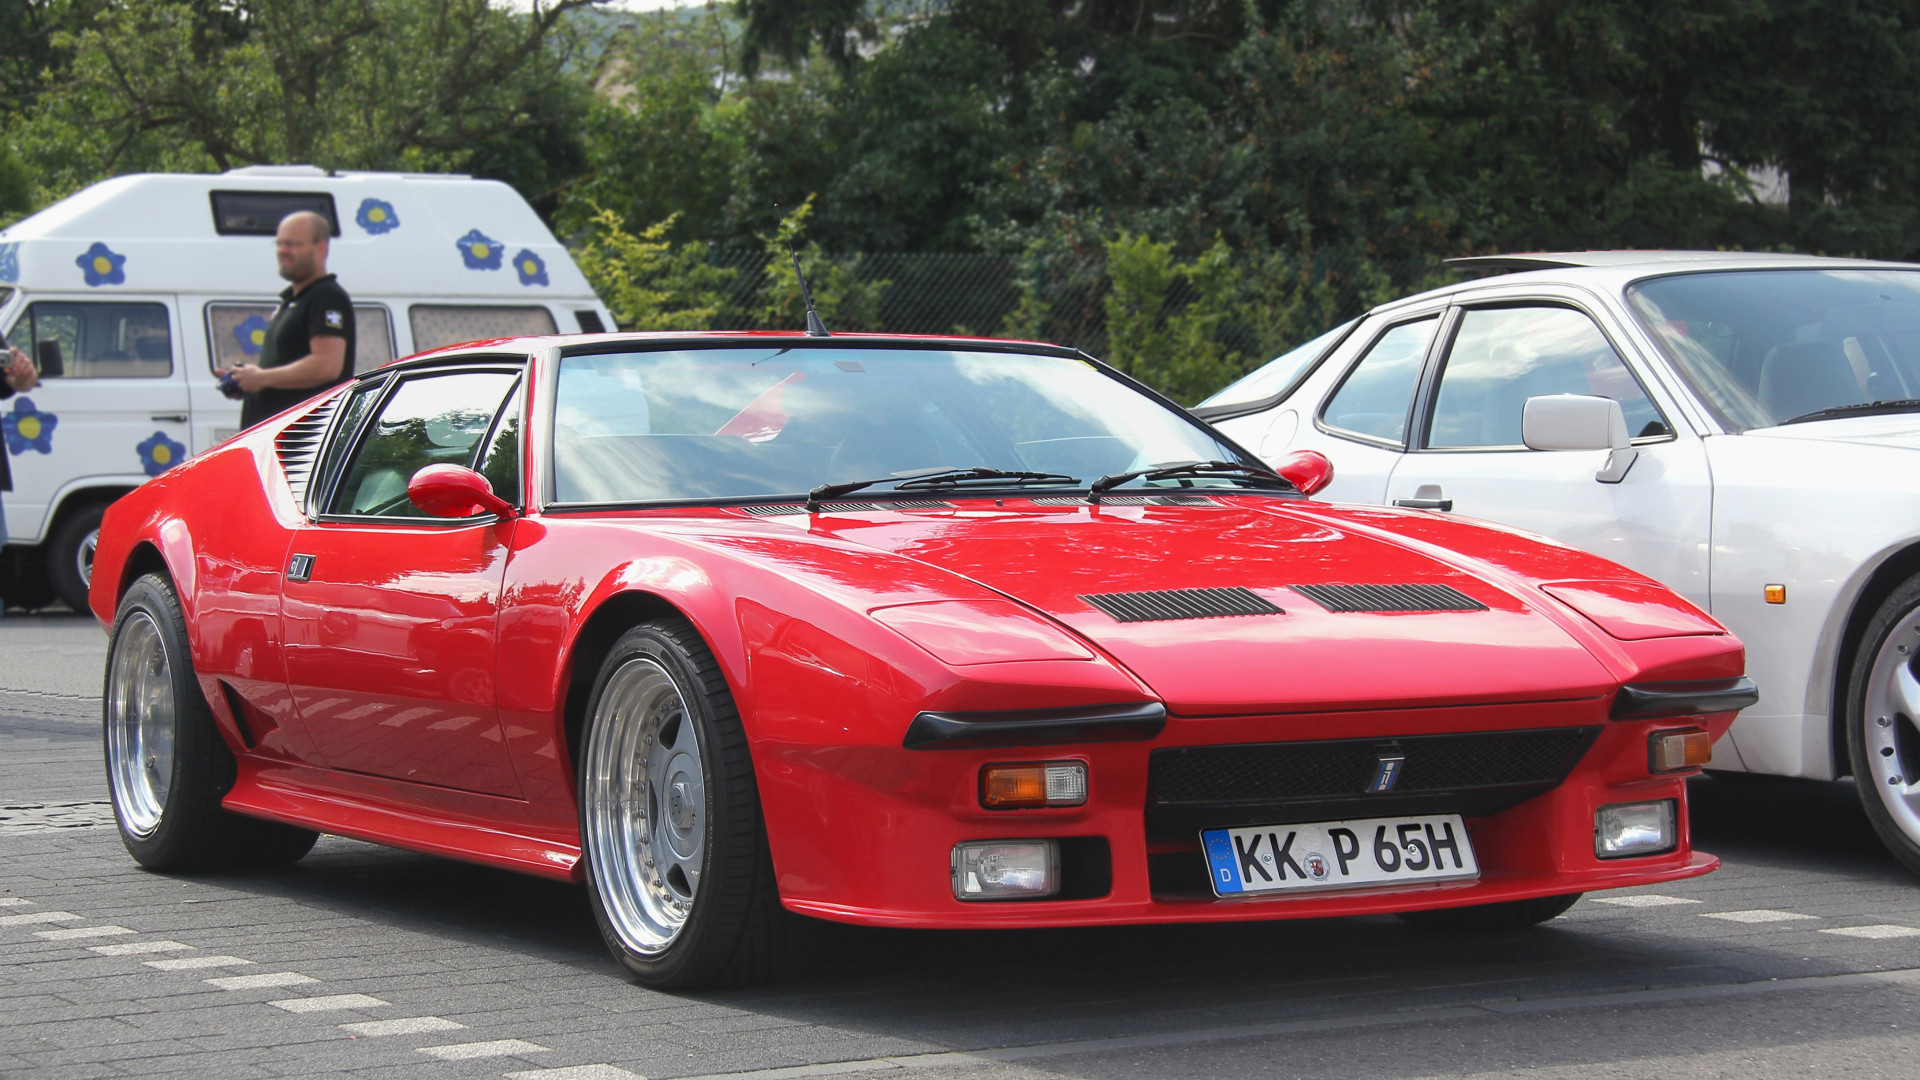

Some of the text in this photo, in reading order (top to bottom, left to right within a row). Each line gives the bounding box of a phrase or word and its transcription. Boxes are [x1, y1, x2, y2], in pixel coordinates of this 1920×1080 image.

[1234, 822, 1463, 883] KK P 65H
[1220, 868, 1232, 882] D
